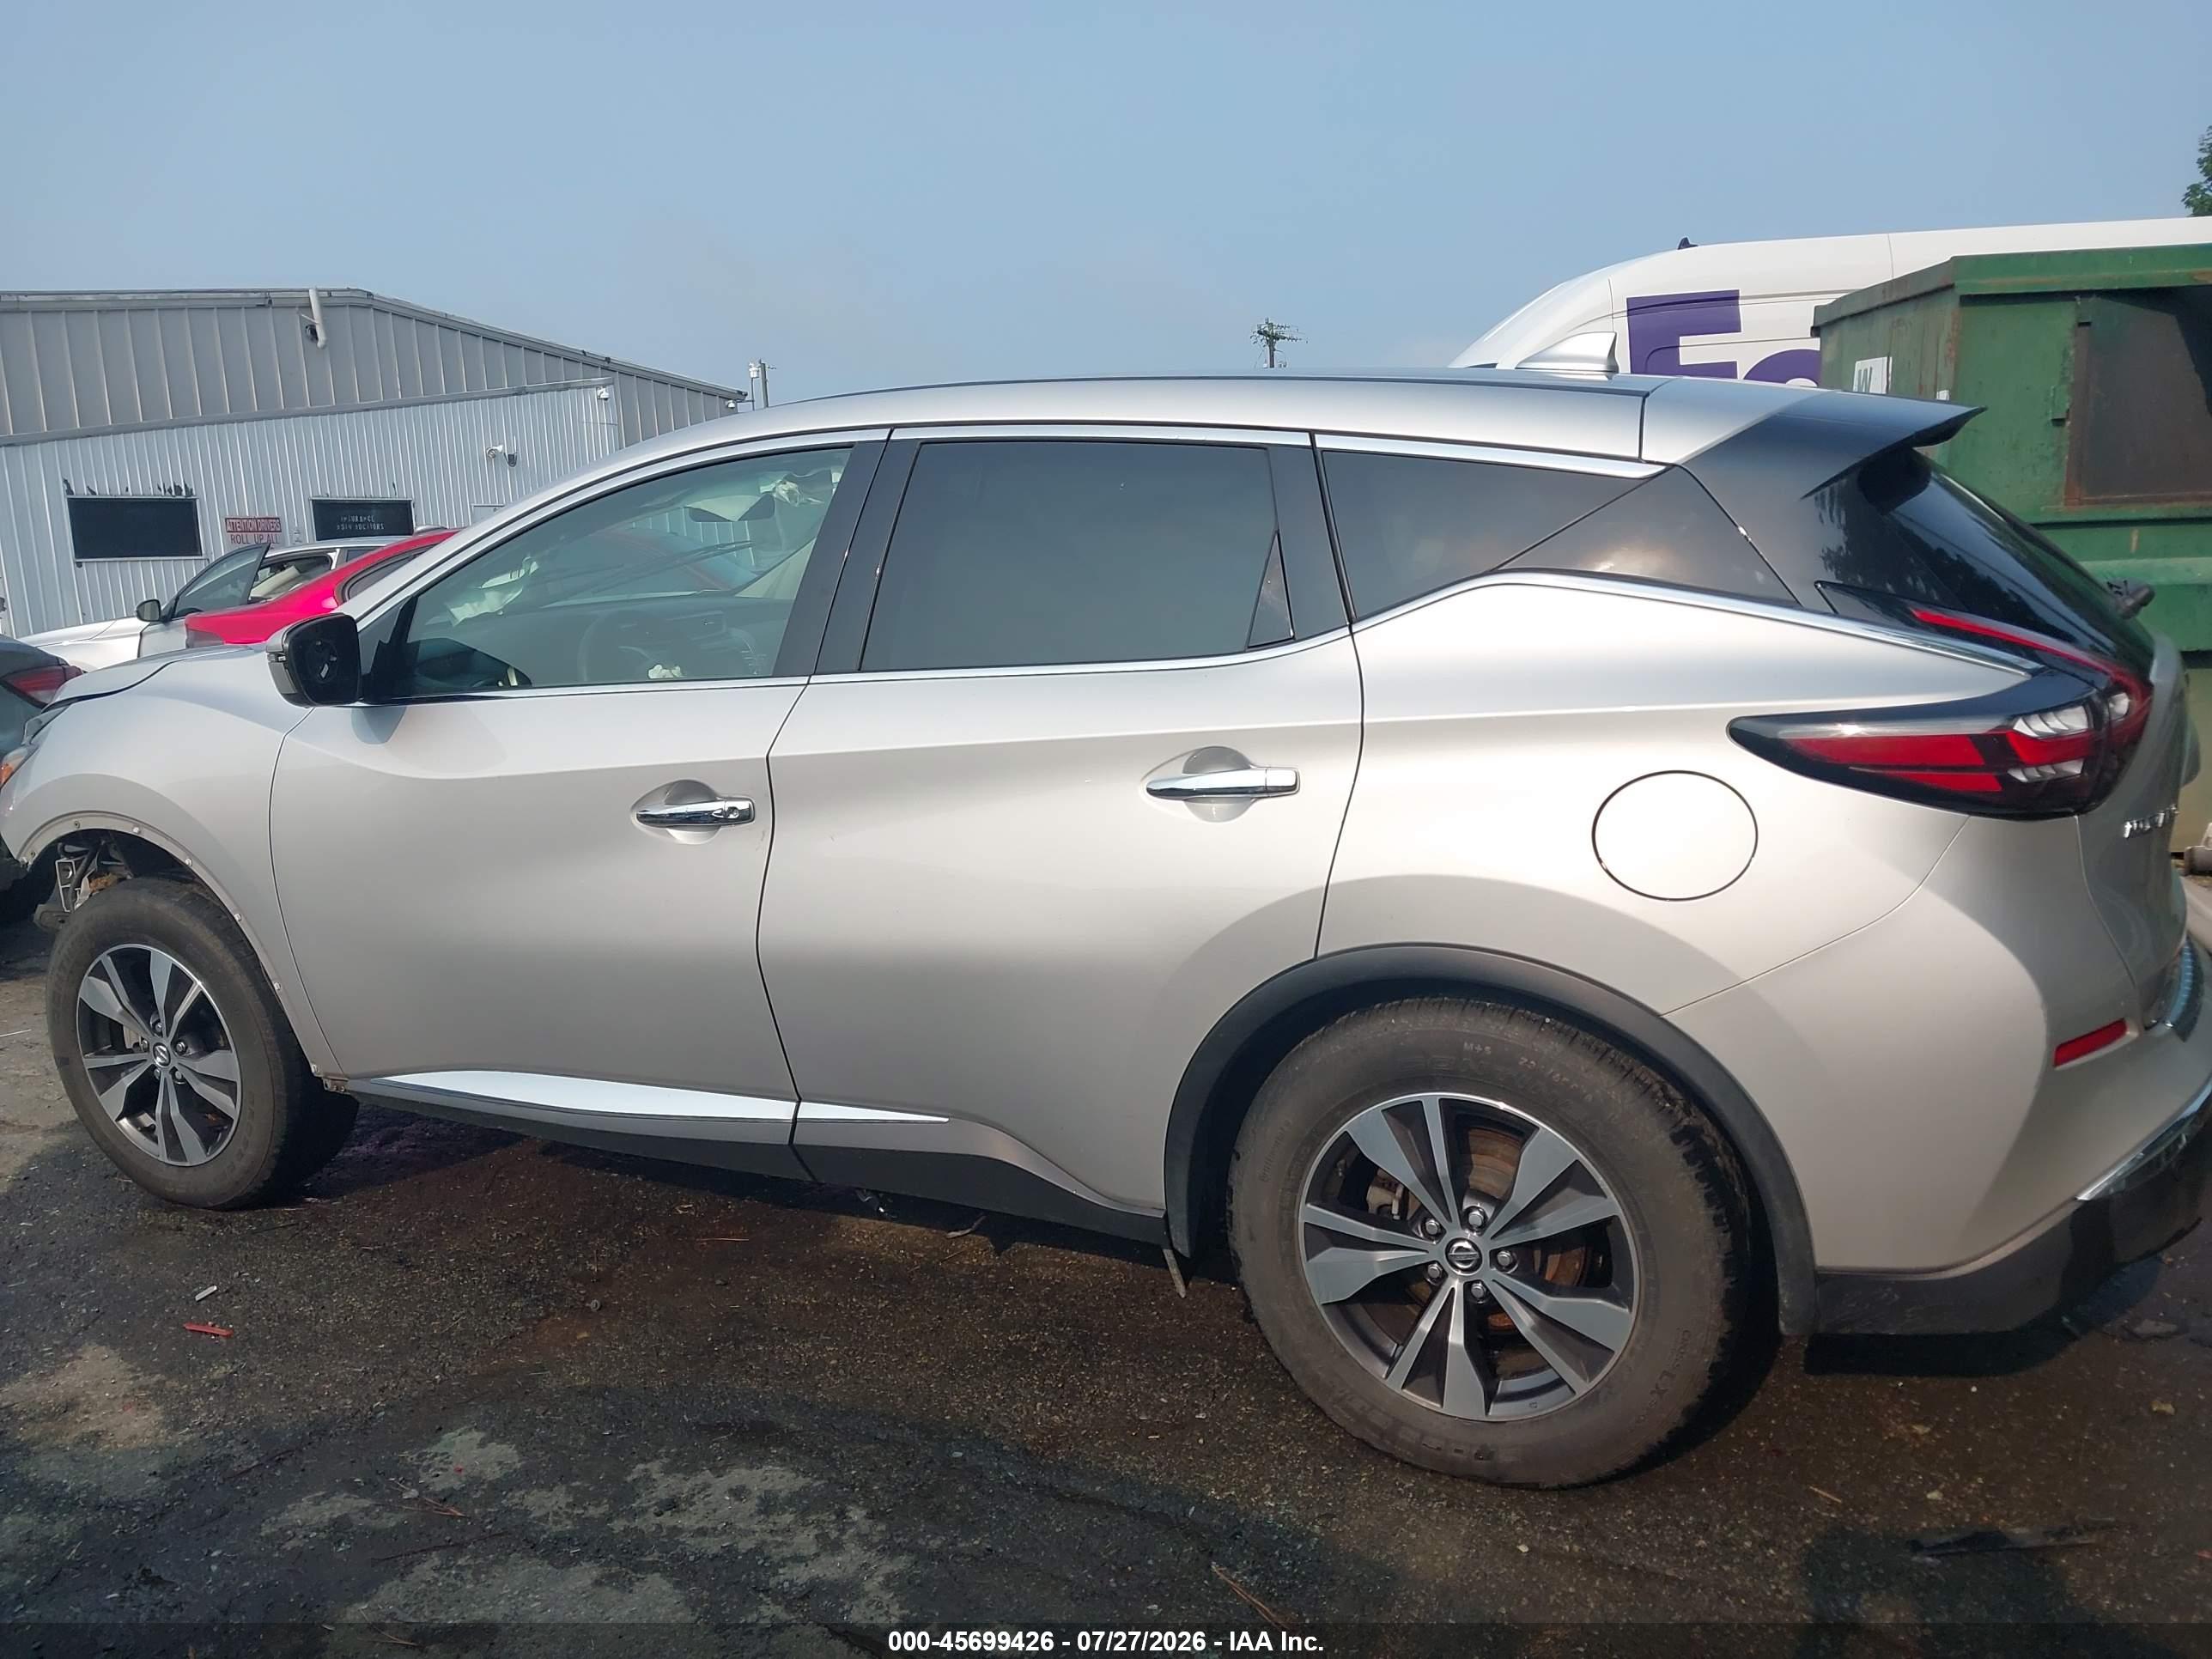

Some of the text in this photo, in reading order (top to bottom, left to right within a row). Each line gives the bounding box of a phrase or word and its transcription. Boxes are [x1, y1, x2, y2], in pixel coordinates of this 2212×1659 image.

[226, 519, 282, 532] ATTENTION DRIVERS
[230, 533, 281, 544] ROLL UP ALL
